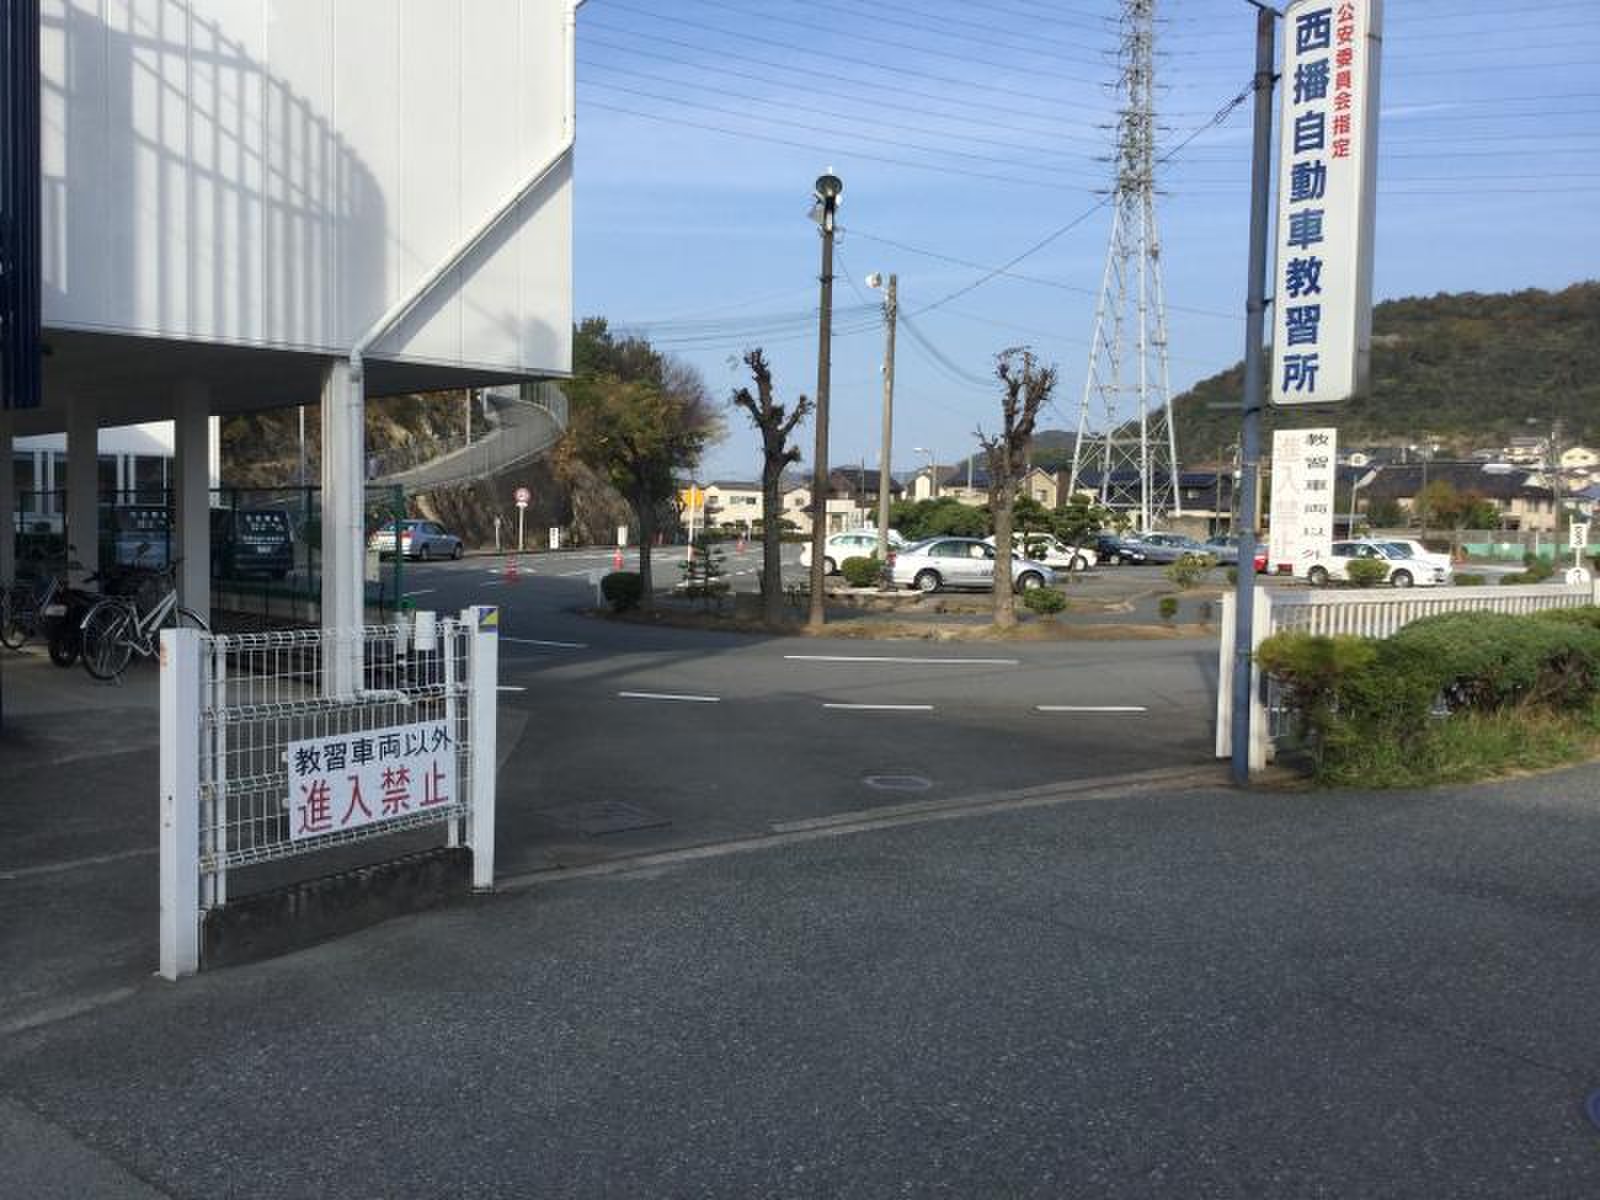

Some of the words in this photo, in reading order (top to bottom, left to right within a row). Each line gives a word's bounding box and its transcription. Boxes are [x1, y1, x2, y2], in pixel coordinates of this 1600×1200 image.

[1332, 2, 1355, 159] 公安委員会指定
[1281, 7, 1332, 393] 西播自動車教習所
[295, 725, 451, 776] 教習車両以外
[297, 760, 448, 833] 進入禁止
